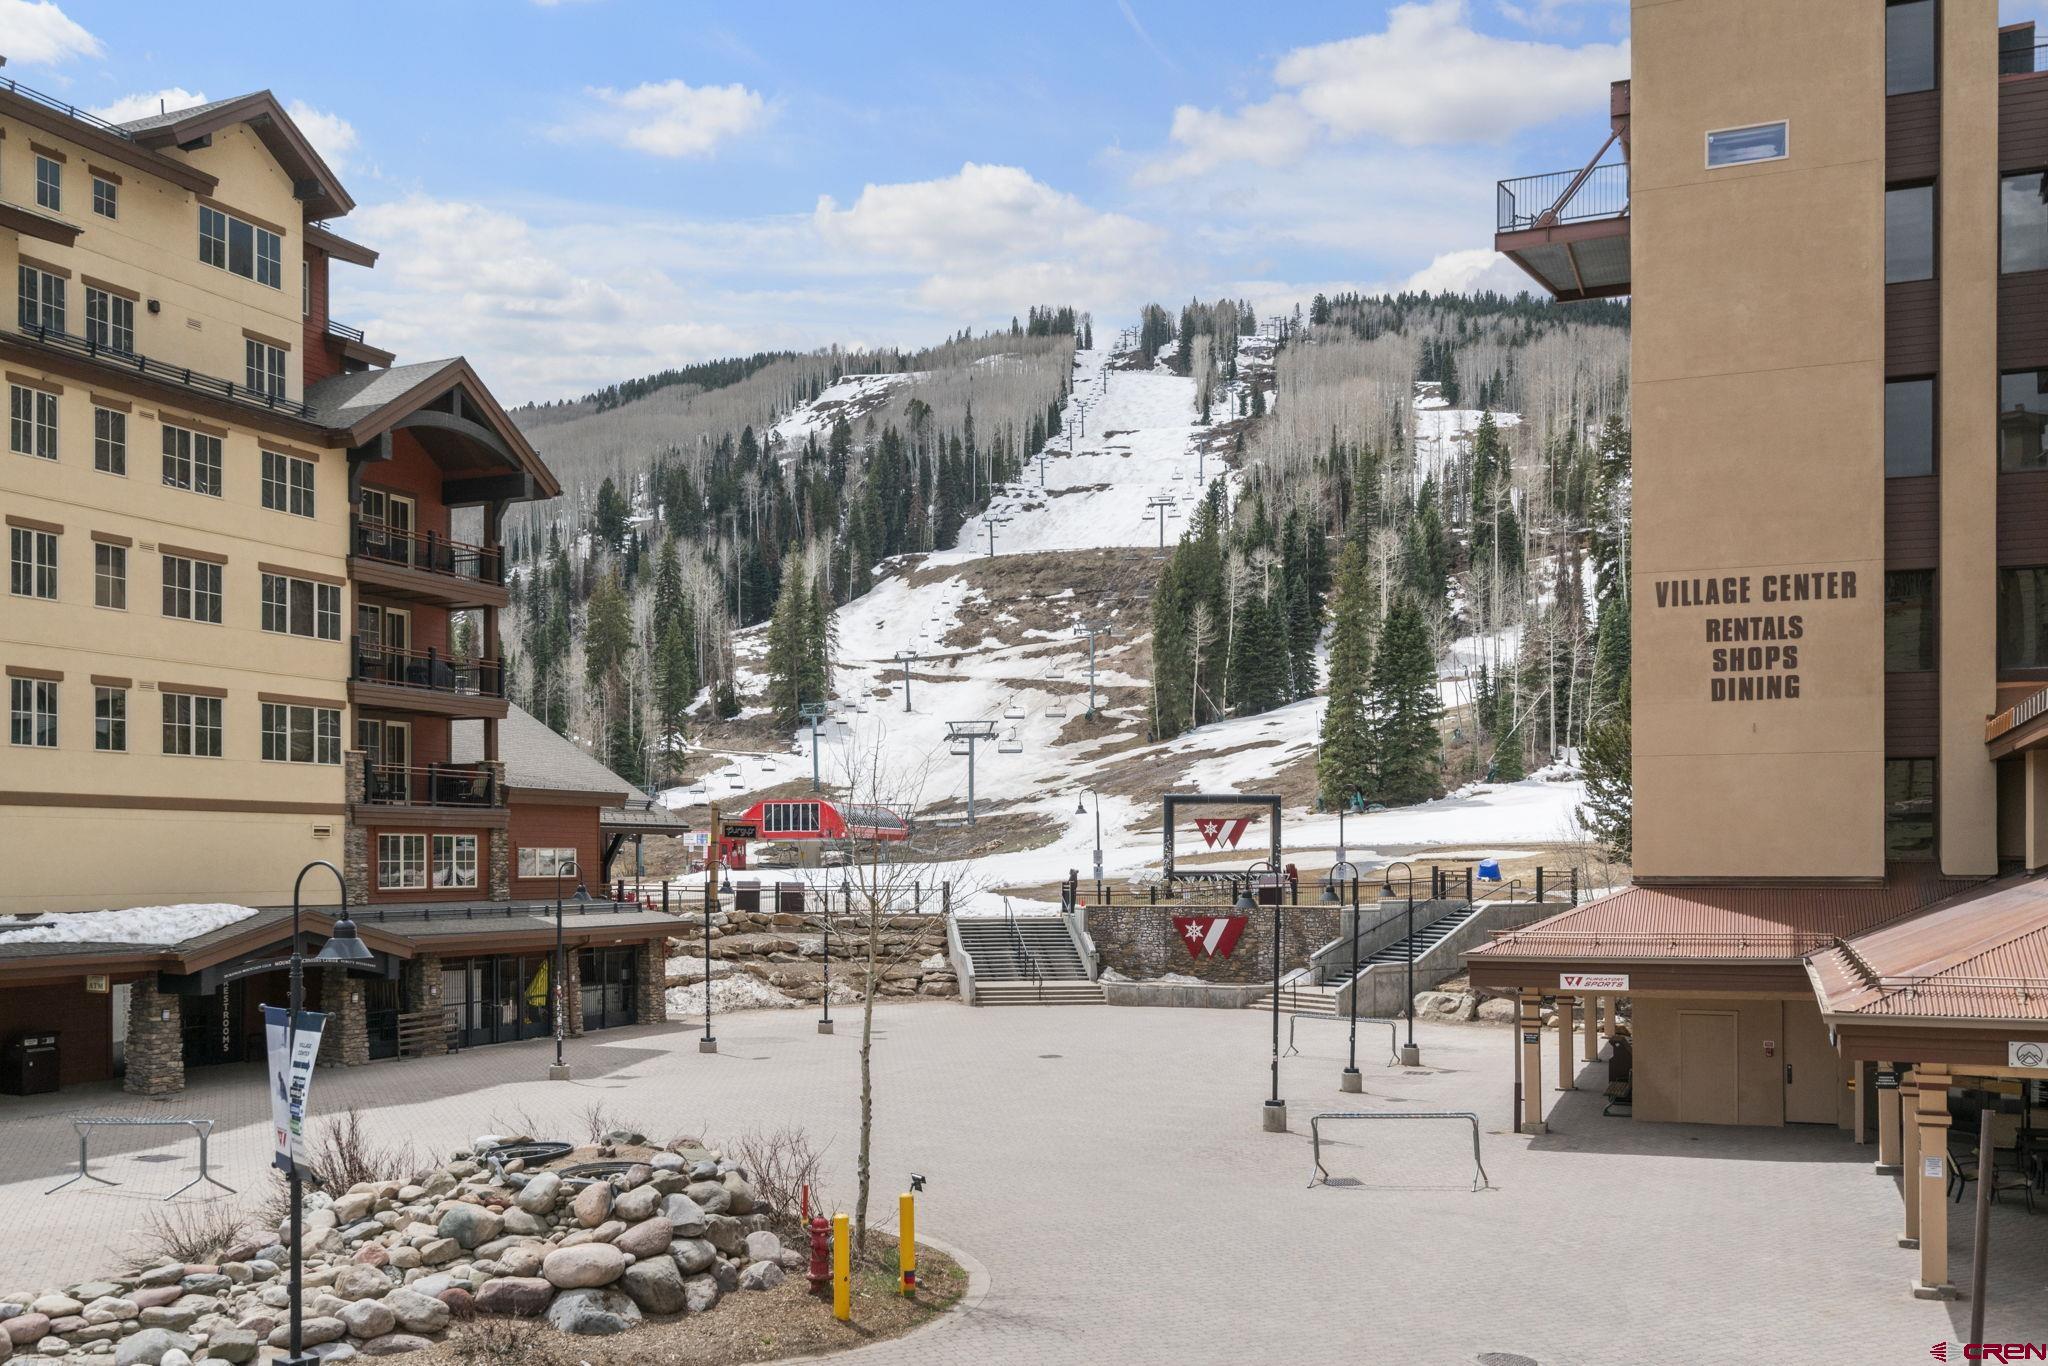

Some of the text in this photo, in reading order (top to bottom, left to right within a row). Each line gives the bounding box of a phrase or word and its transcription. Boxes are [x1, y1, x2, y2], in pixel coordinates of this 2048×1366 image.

[1655, 571, 1857, 608] VILLAGE CENTER
[1706, 615, 1804, 642] RENTALS
[1712, 646, 1798, 672] SHOPS
[1711, 675, 1800, 702] DINING
